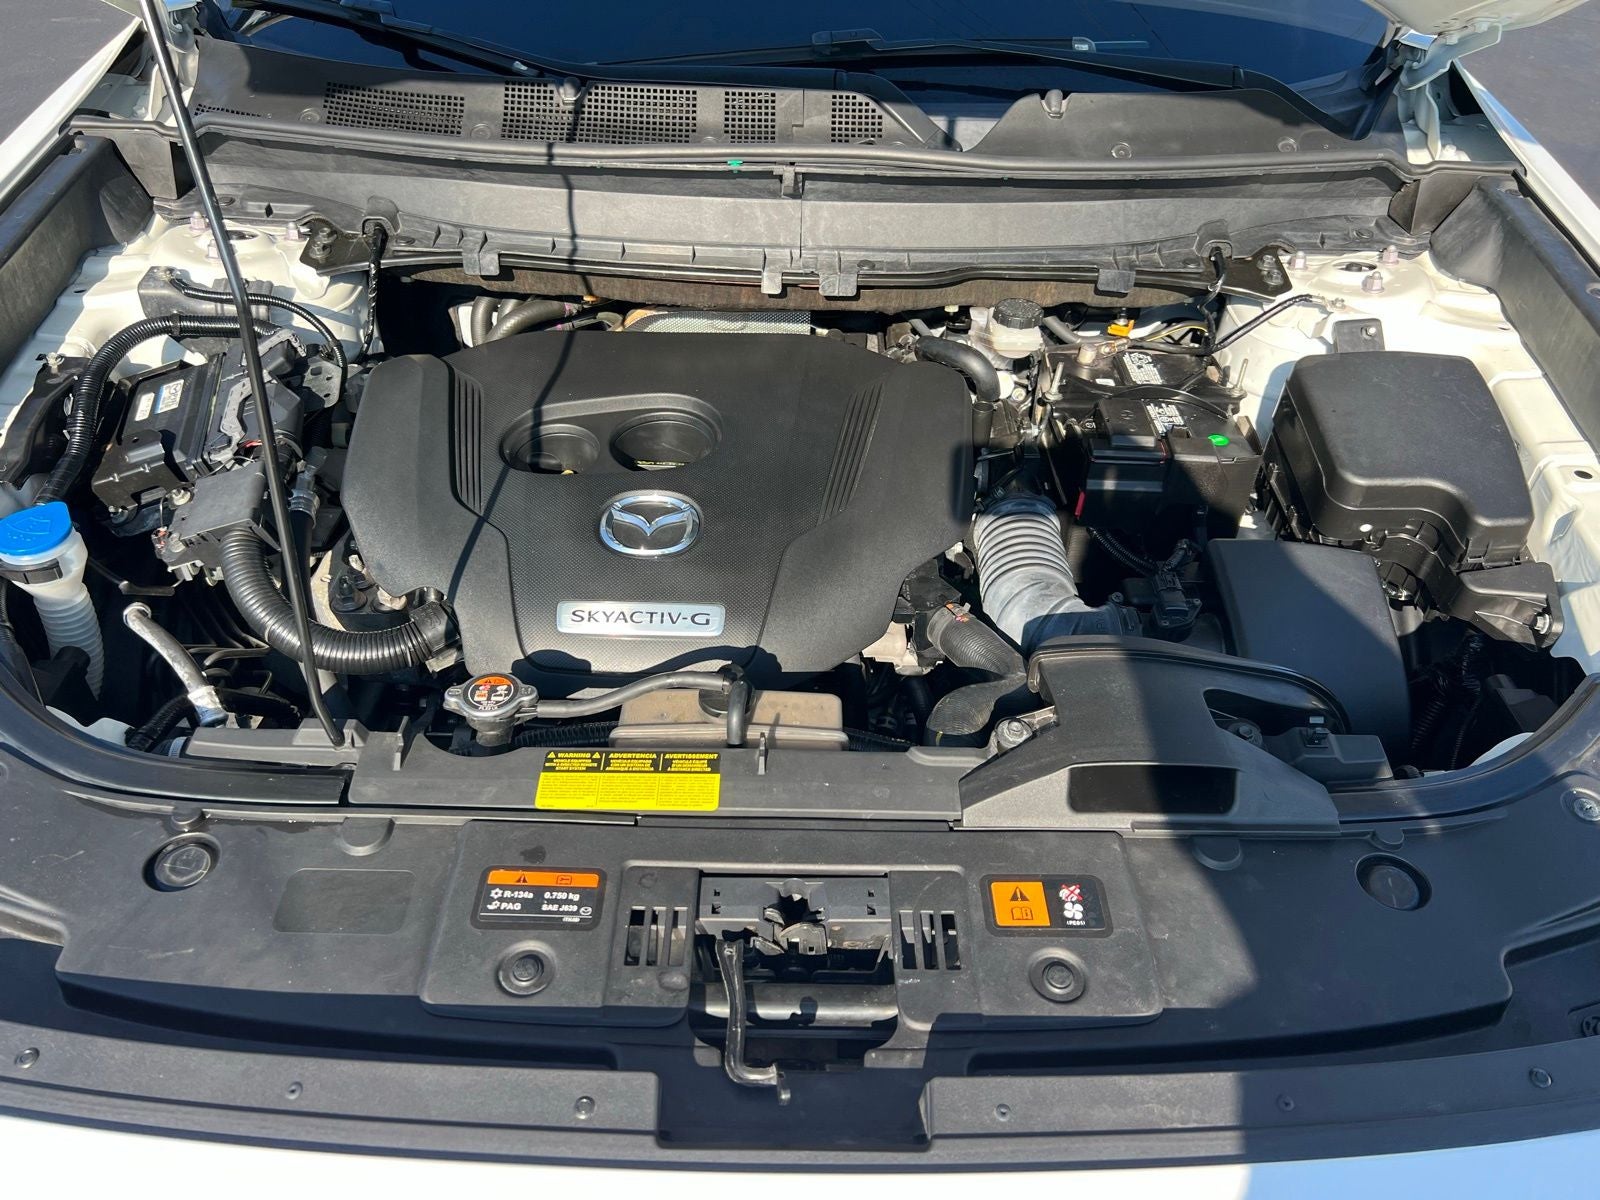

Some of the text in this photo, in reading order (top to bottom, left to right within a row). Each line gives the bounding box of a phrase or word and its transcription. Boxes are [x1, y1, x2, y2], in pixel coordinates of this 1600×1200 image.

[571, 609, 711, 626] SKYACTIV-G
[503, 891, 534, 899] R-134a
[568, 892, 580, 901] kg
[500, 902, 522, 910] PAG
[559, 904, 578, 912] J639
